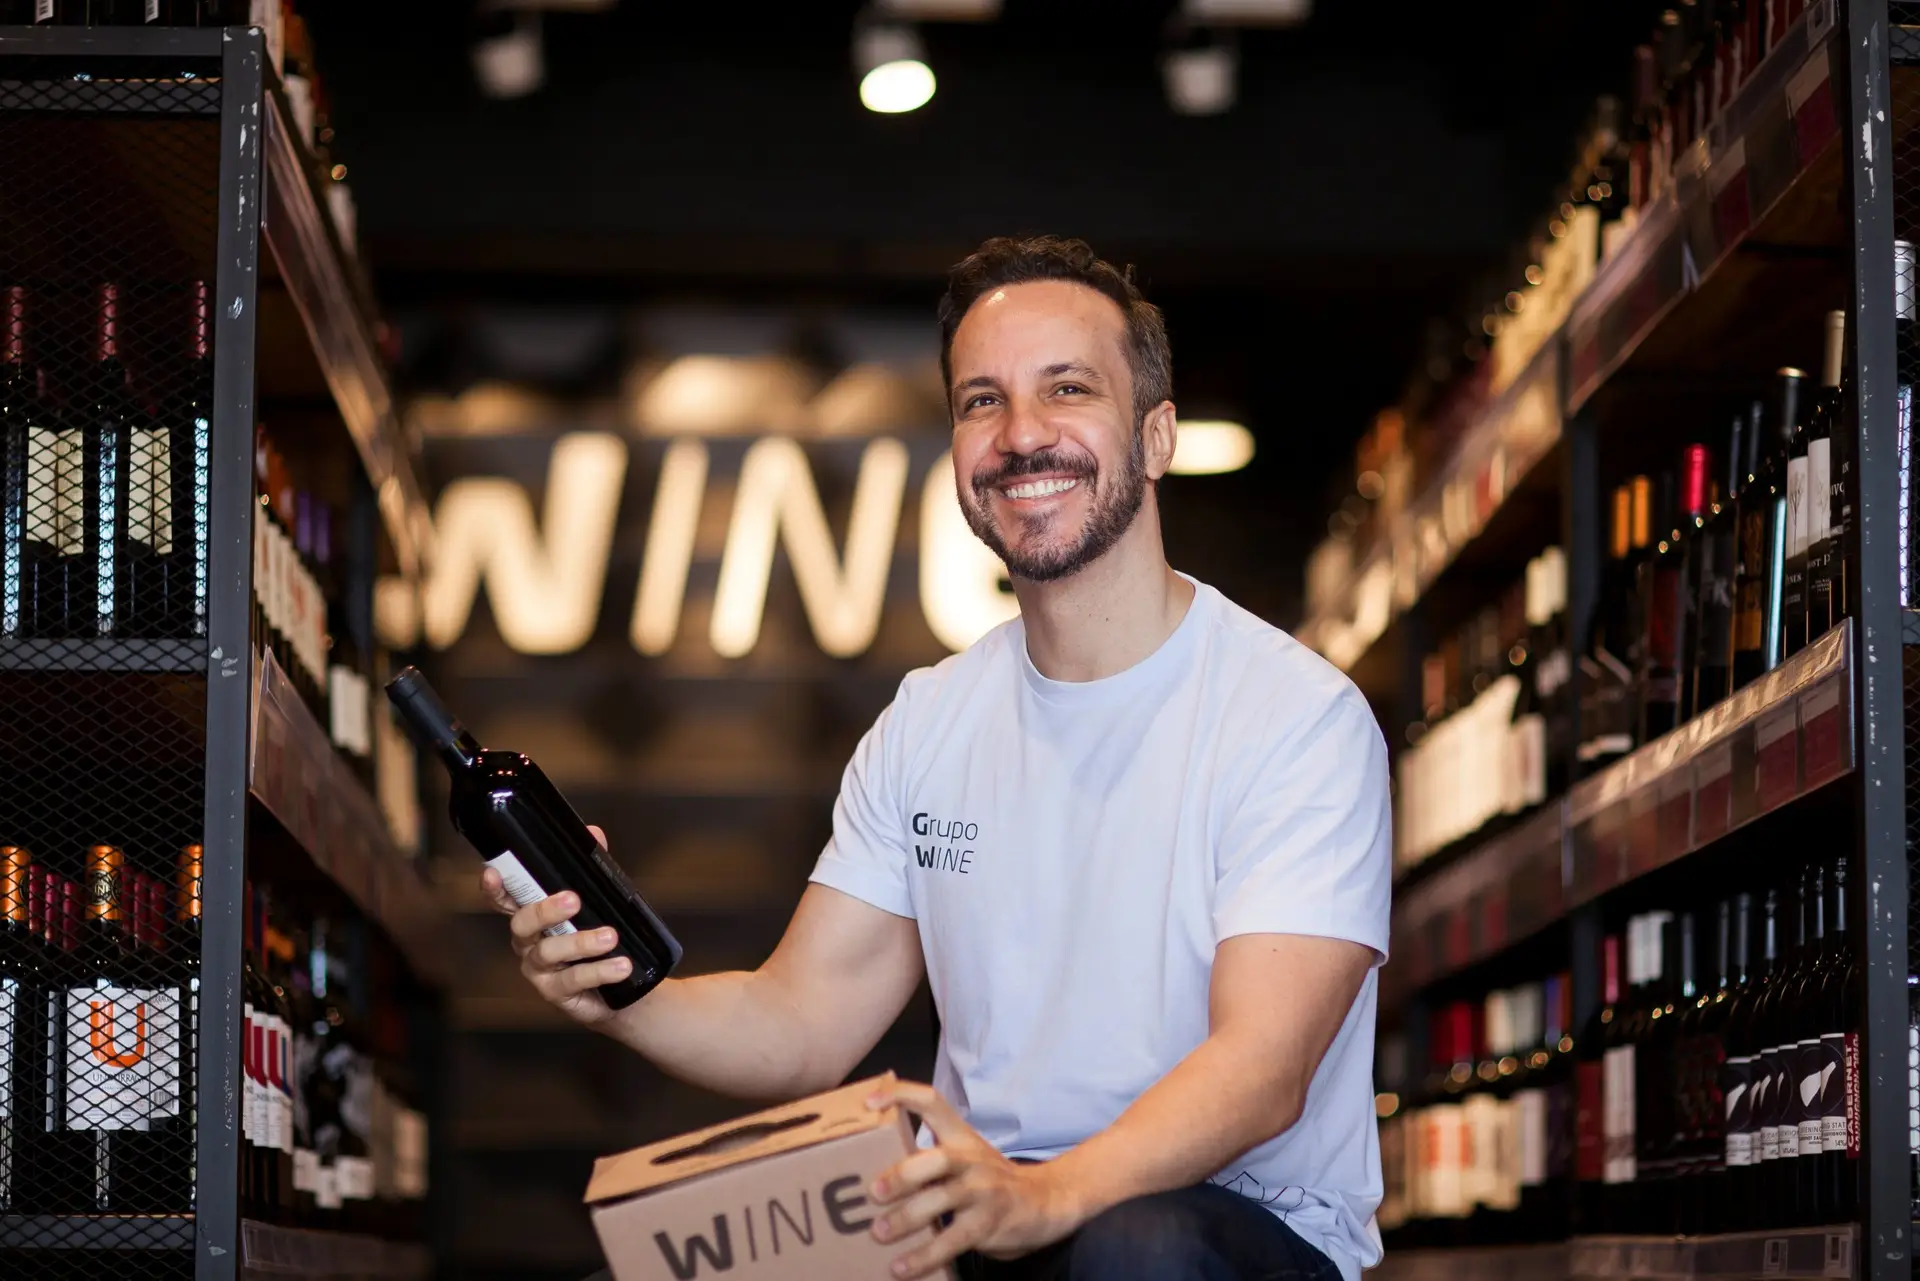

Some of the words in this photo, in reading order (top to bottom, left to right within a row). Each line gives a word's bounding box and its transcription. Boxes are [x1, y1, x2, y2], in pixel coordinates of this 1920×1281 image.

[912, 812, 979, 845] Grupo
[914, 844, 975, 875] WINE
[90, 1000, 146, 1069] U
[1845, 1044, 1855, 1148] CABERNET
[653, 1173, 876, 1281] WINE
